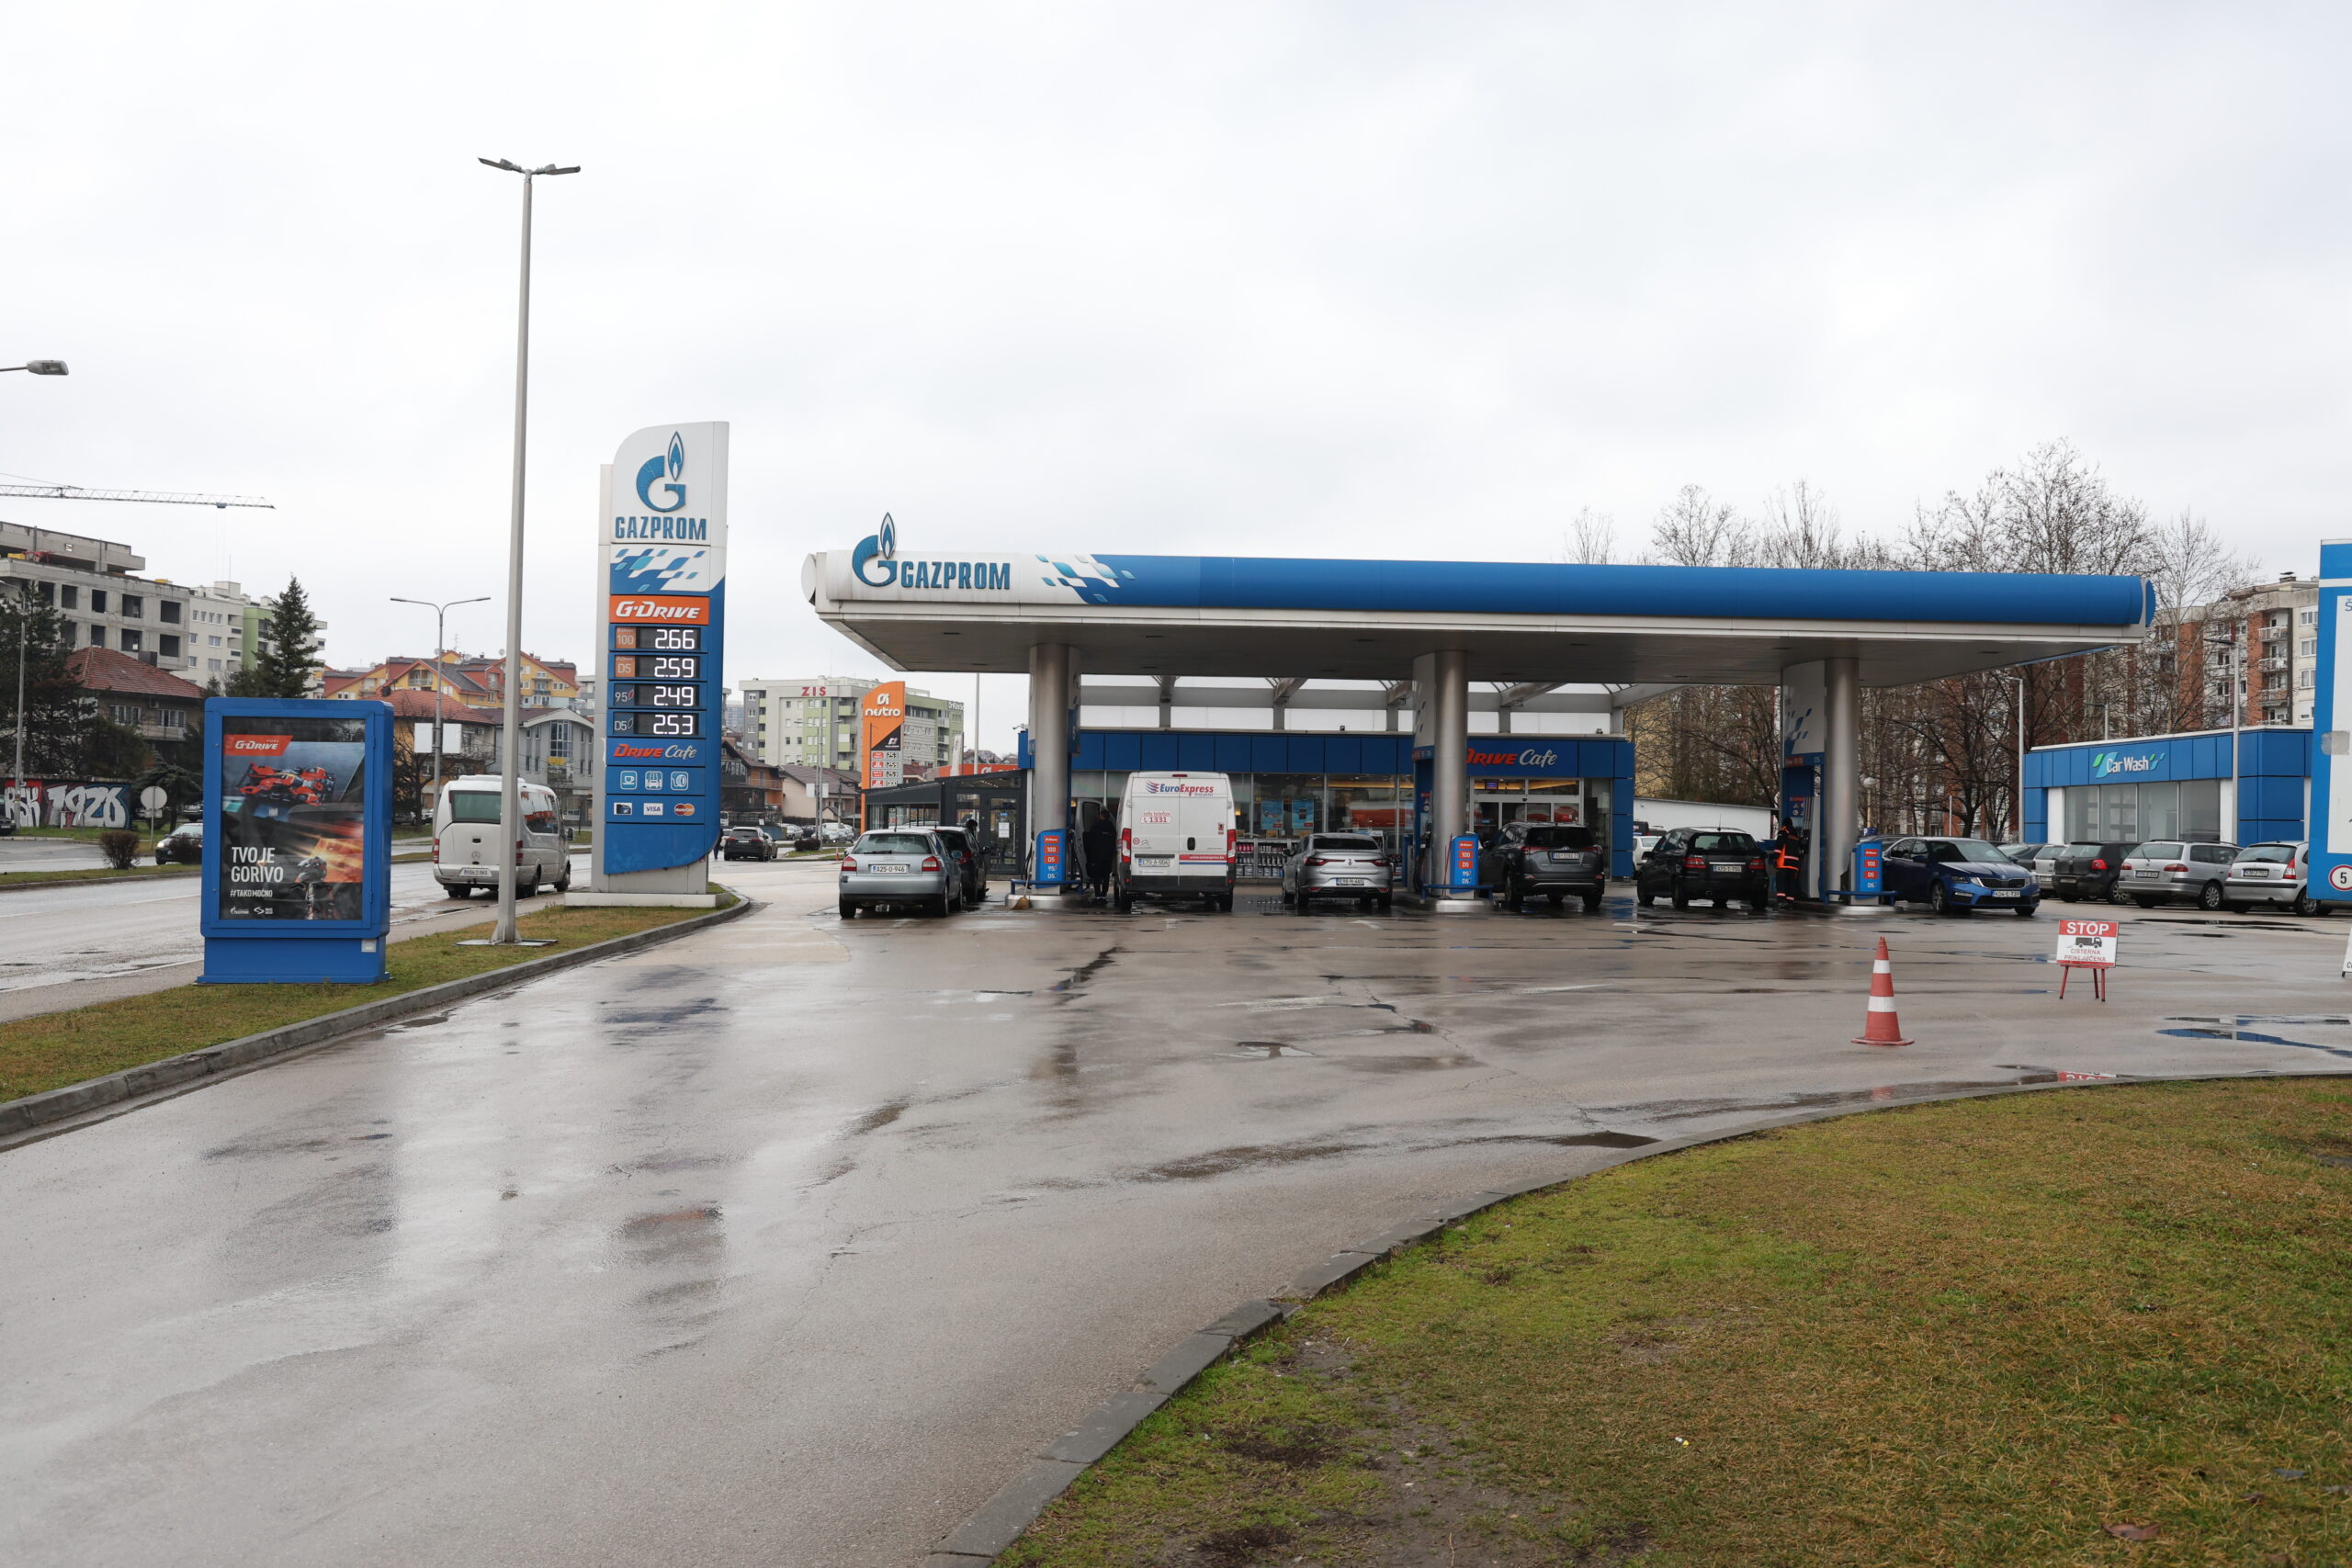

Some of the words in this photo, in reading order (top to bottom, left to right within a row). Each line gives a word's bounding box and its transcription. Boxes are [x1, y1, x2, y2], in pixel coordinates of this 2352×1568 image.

[615, 516, 707, 540] GAZPROM
[900, 560, 1011, 590] GAZPROM
[616, 635, 633, 645] 100
[655, 629, 695, 649] 2.66
[617, 663, 631, 673] D5
[654, 658, 695, 678] 2.59
[615, 692, 628, 702] 95
[654, 686, 694, 706] 2.49
[865, 706, 900, 716] nestro
[614, 721, 627, 731] D5
[653, 715, 693, 735] 2.53
[614, 743, 664, 760] DRIVE
[664, 744, 697, 761] Cafe
[1519, 749, 1558, 768] Cafe
[2106, 758, 2123, 773] Car
[2123, 755, 2149, 772] Wash
[1159, 783, 1215, 796] EuroExpress
[232, 846, 276, 863] TVOJE
[231, 866, 284, 883] GORIVO
[2340, 872, 2347, 885] 5
[2066, 921, 2109, 935] STOP
